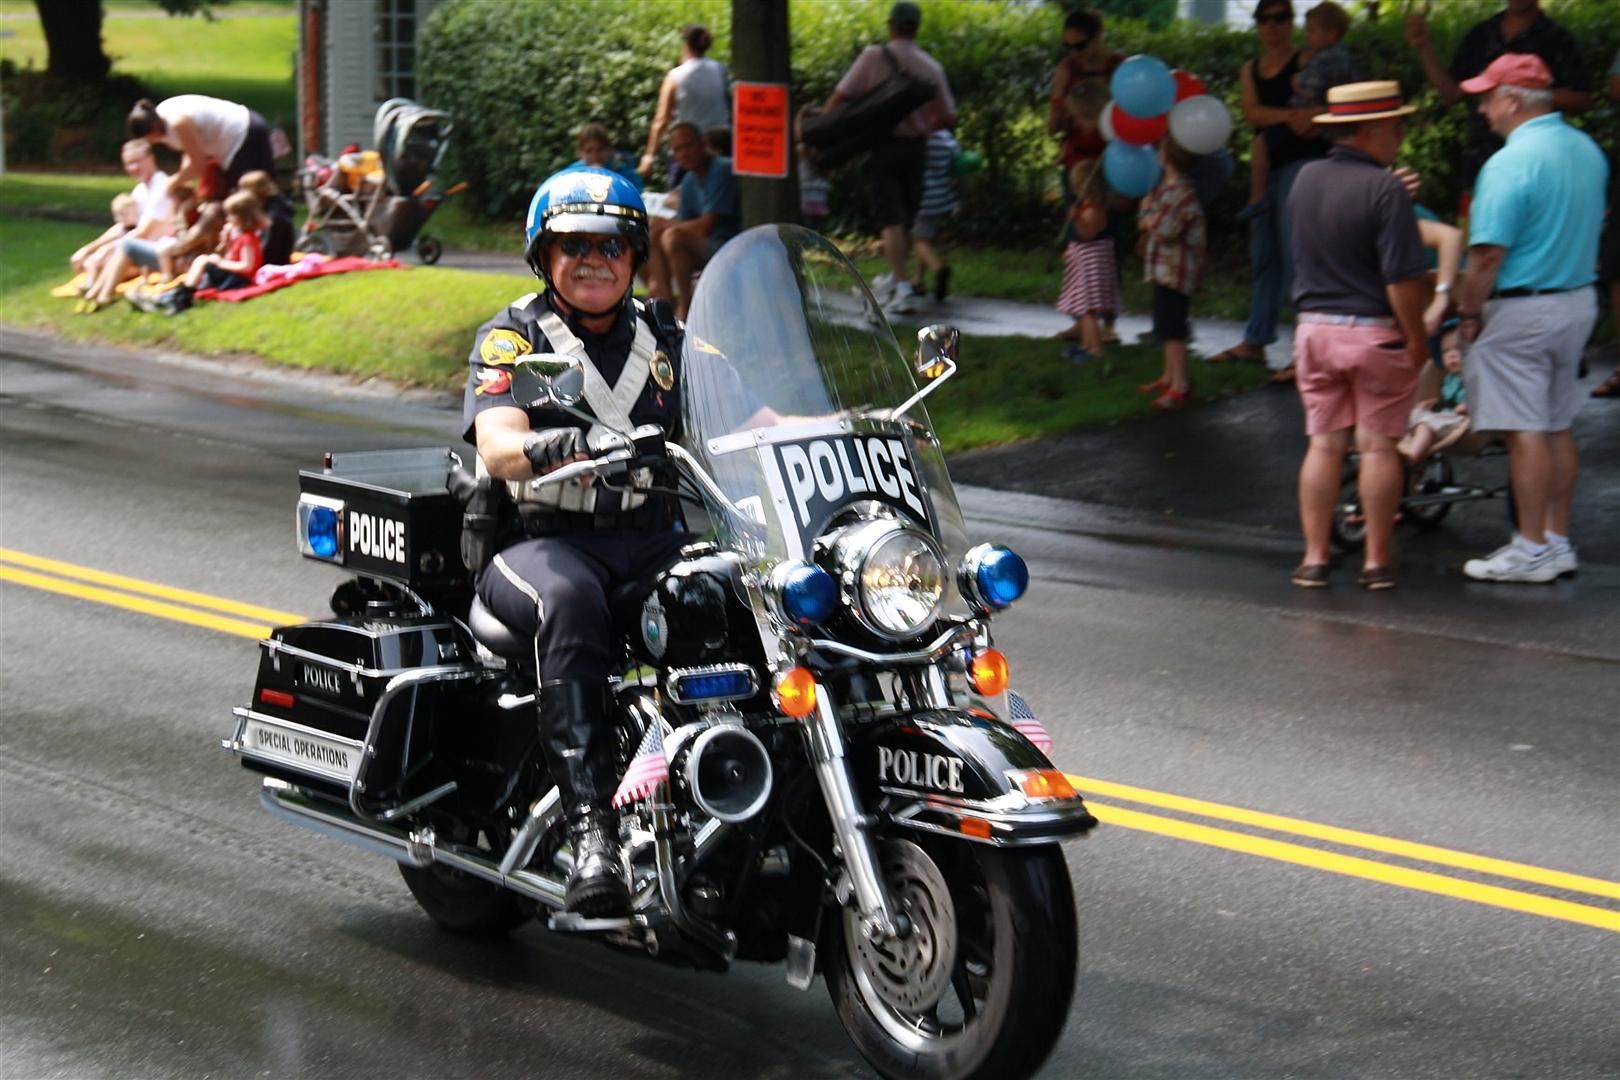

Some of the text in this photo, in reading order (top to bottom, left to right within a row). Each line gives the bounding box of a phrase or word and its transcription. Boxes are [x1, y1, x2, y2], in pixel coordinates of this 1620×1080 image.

[780, 437, 926, 528] POLICE
[350, 511, 405, 563] POLICE
[303, 664, 340, 693] POLICE
[259, 728, 348, 768] SPECIAL OPERATIONS
[877, 745, 964, 793] POLICE
